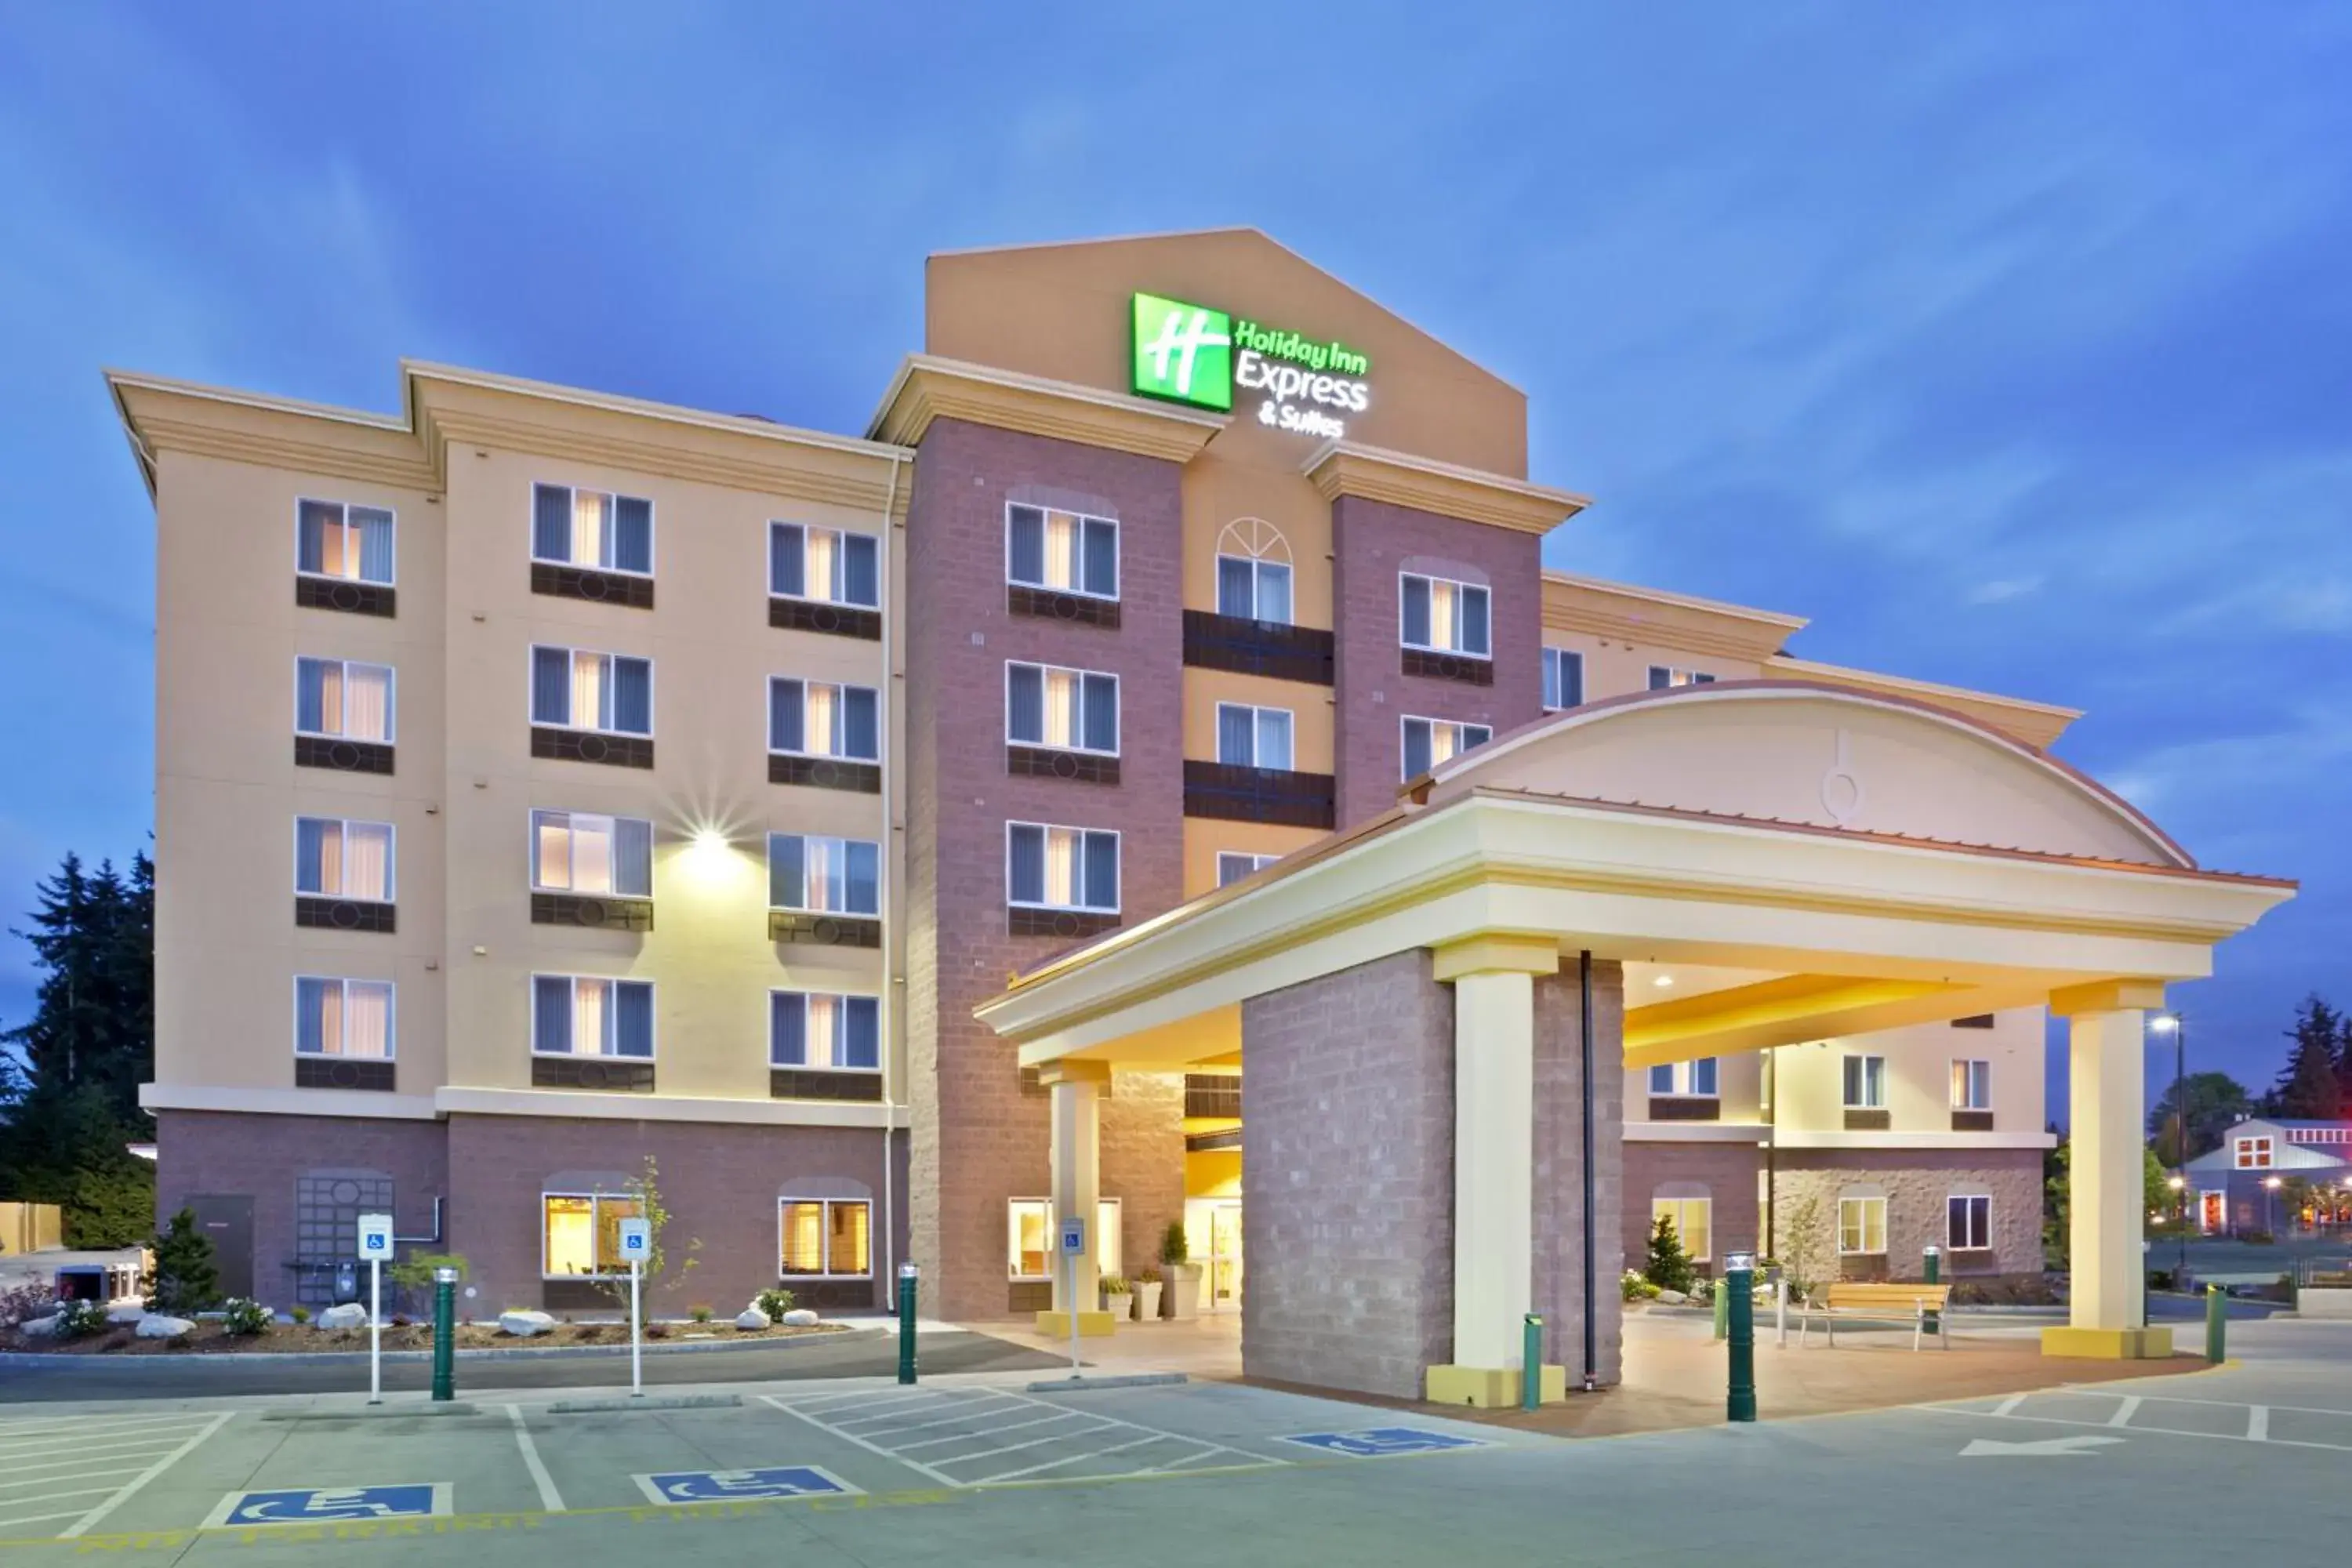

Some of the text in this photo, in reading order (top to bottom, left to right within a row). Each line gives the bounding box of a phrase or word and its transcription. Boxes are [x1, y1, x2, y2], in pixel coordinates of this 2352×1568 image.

[1235, 320, 1367, 376] Holiday Inn
[1236, 349, 1369, 412] Express
[1258, 400, 1345, 438] & Suites
